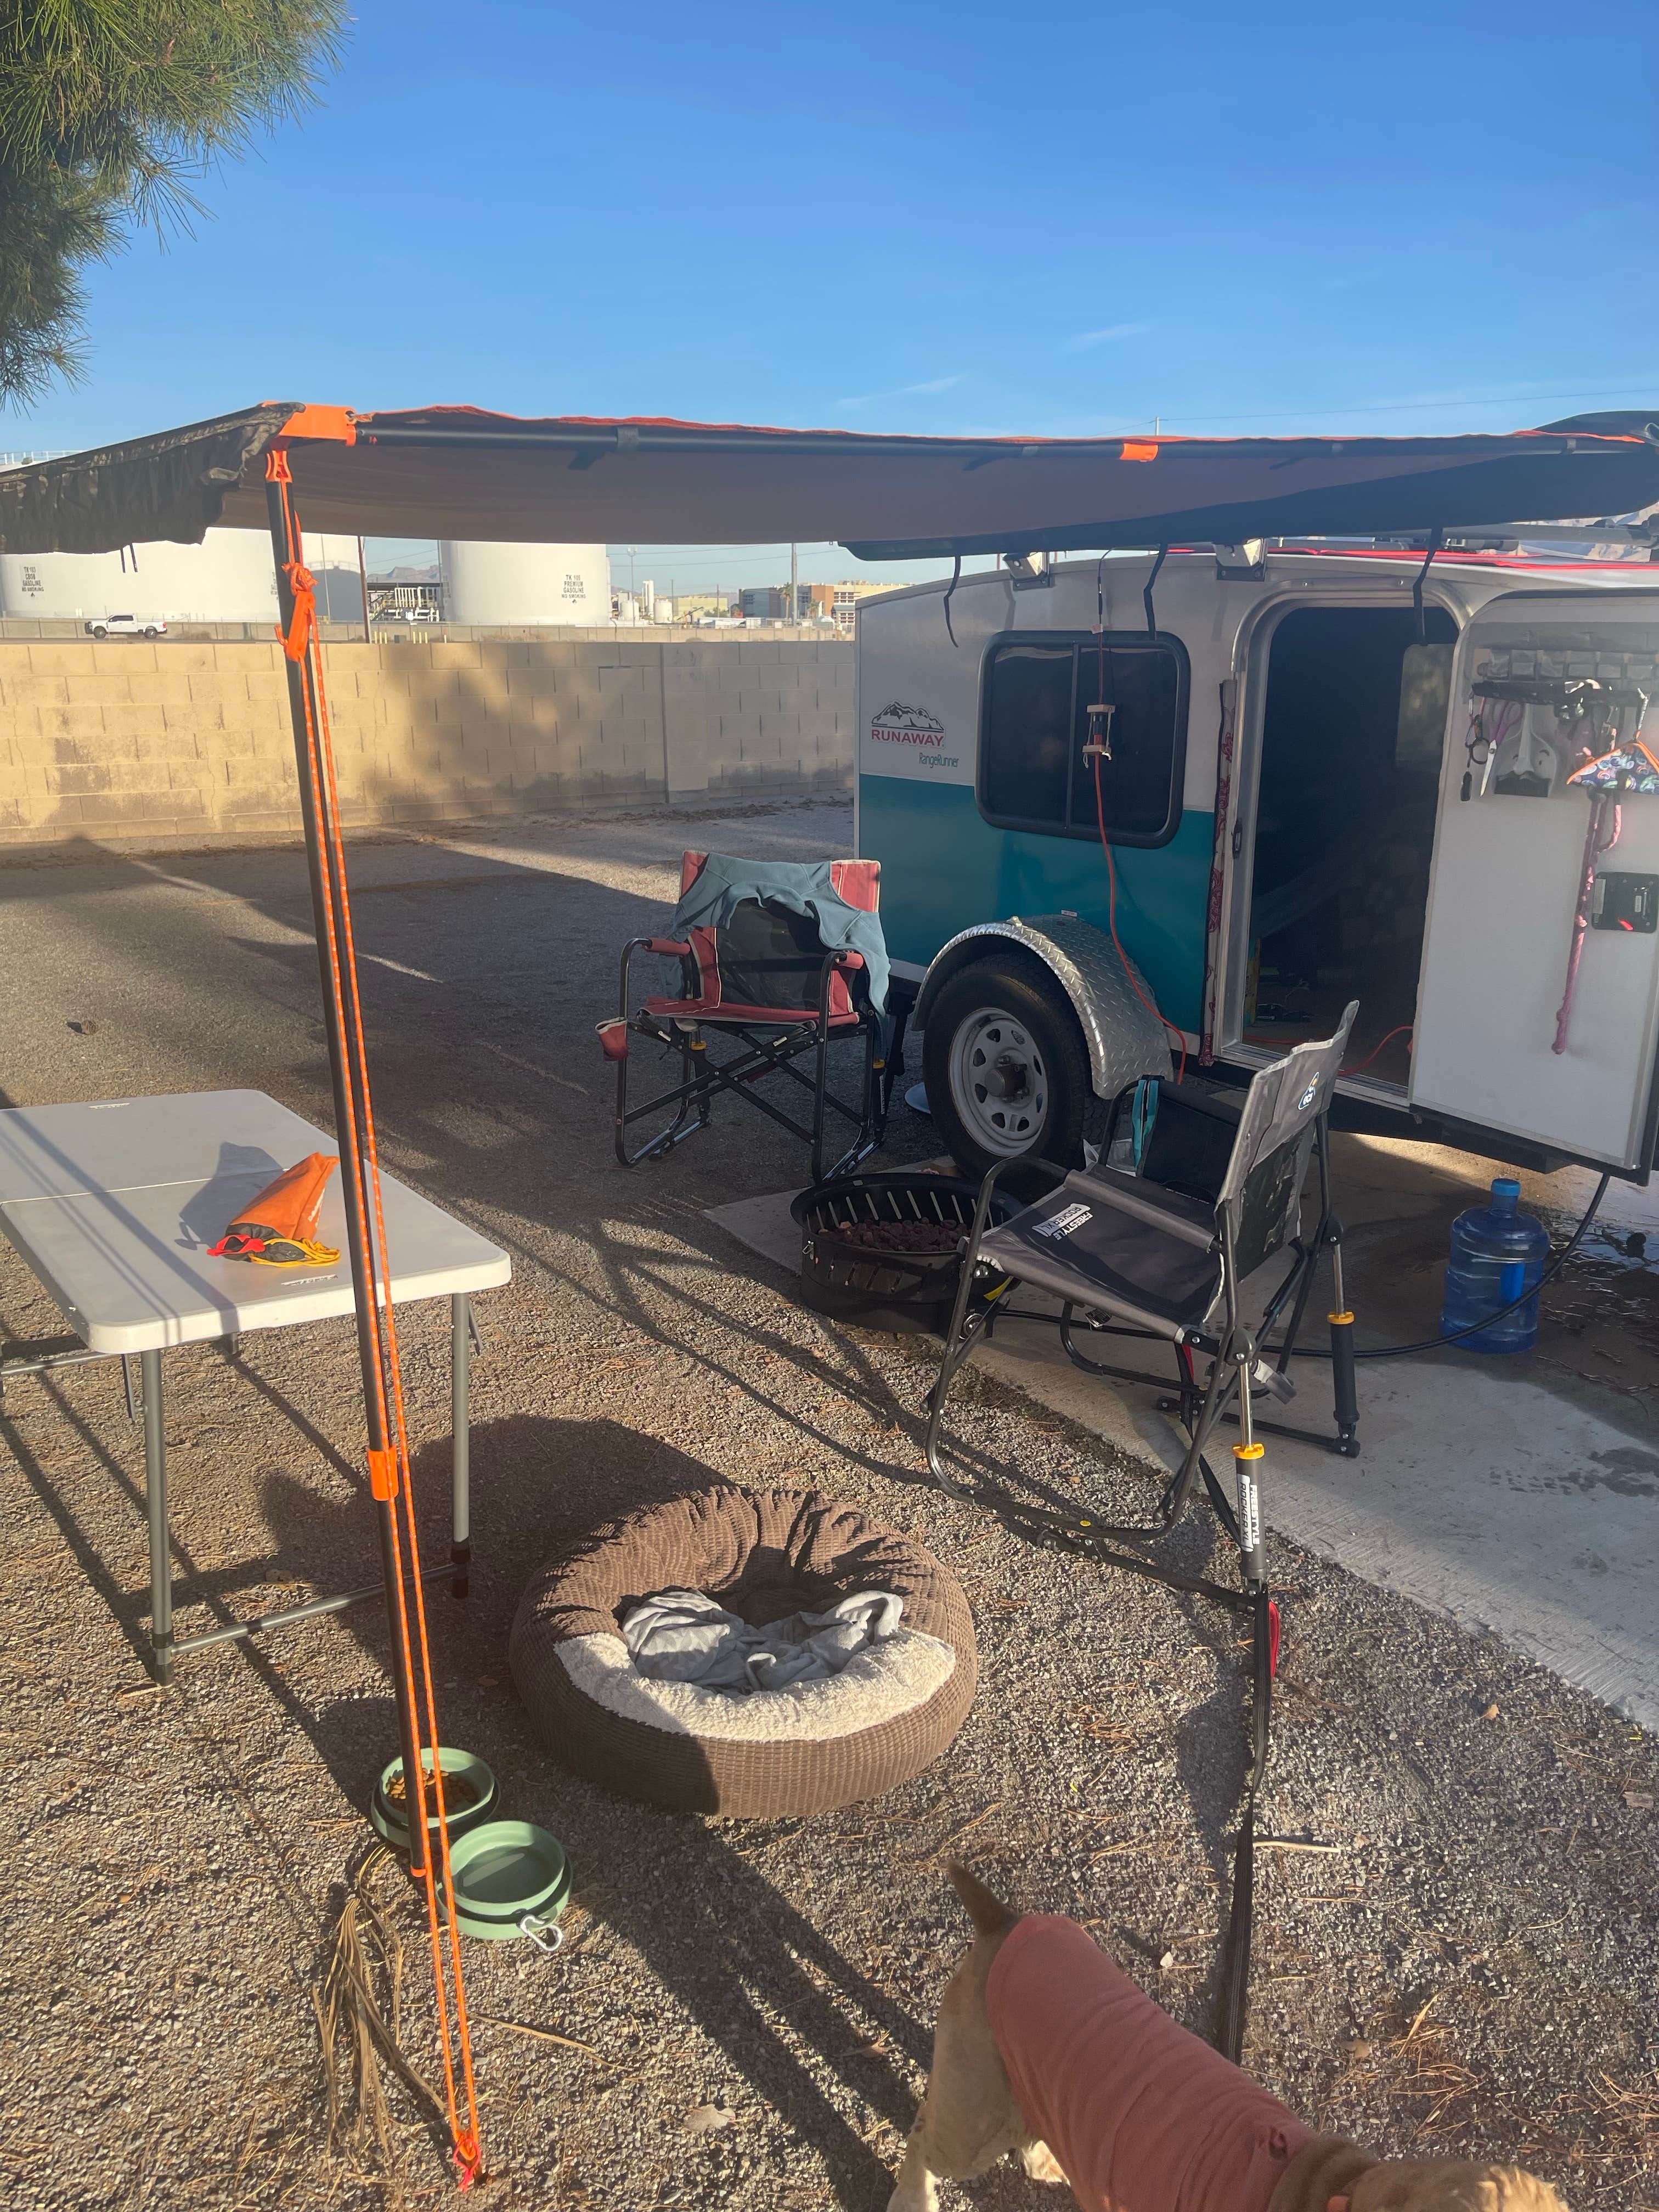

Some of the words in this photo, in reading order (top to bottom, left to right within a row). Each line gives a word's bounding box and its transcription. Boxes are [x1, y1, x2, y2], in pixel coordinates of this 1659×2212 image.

[871, 730, 944, 747] RUNAWAY
[919, 752, 959, 769] RangeRunner
[1053, 1207, 1082, 1225] ROCKER
[1053, 1211, 1093, 1241] FREESTYLE
[1240, 1482, 1248, 1528] ROCKER
[1250, 1485, 1260, 1545] FREESTYLE
[1243, 1530, 1249, 1542] XL
